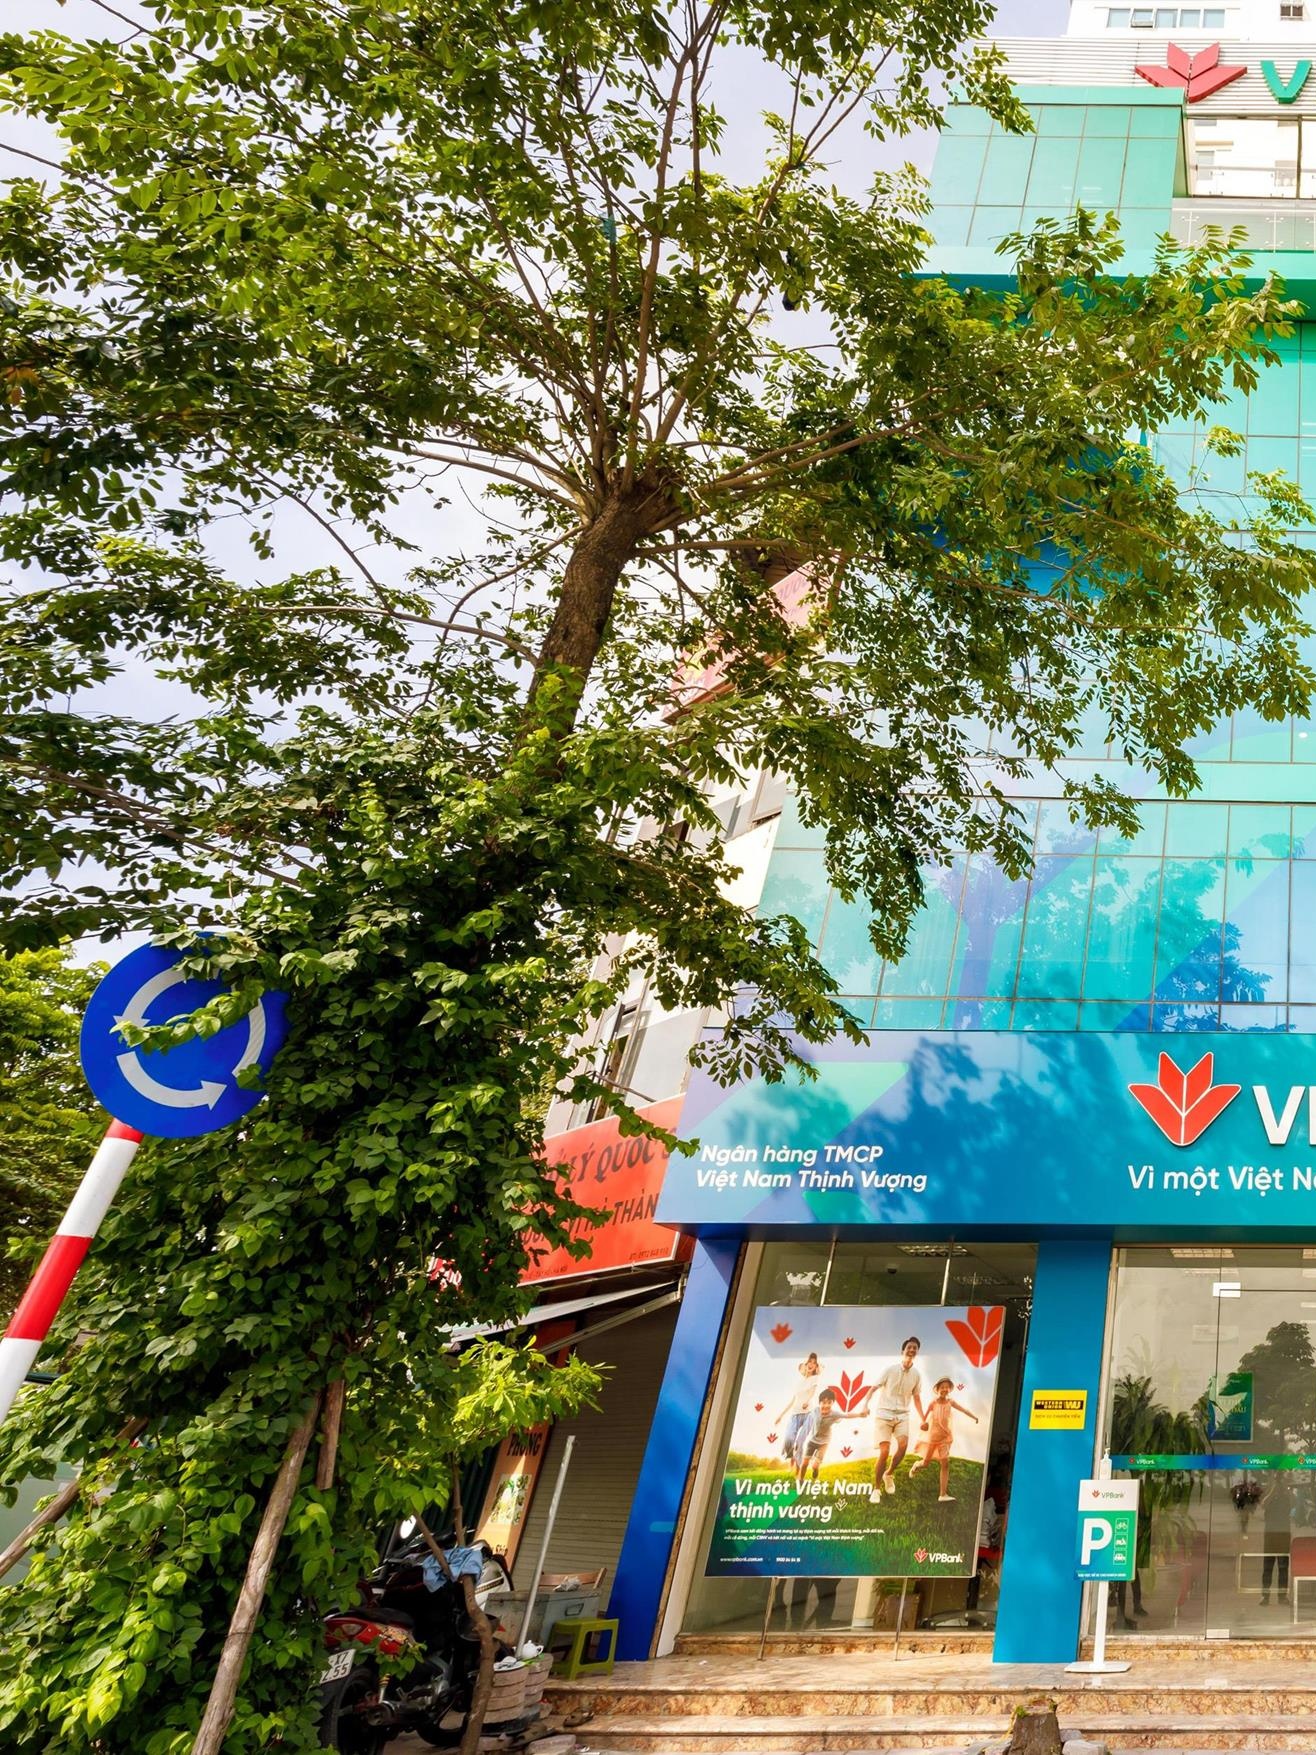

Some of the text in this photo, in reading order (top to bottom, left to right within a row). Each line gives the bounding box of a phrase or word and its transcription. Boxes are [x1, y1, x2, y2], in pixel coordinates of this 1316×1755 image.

[701, 1145, 758, 1166] Ngân
[763, 1145, 818, 1167] hàng
[824, 1145, 883, 1162] TMCP
[696, 1169, 927, 1193] Việt Nam Thịnh Vượng
[1128, 1165, 1155, 1190] Vì
[1163, 1166, 1219, 1197] một
[1228, 1166, 1283, 1197] Việt
[735, 1479, 752, 1496] Vì
[755, 1479, 791, 1500] một
[795, 1479, 829, 1500] Việt
[730, 1502, 832, 1523] thịnh vượng
[1080, 1518, 1113, 1566] P
